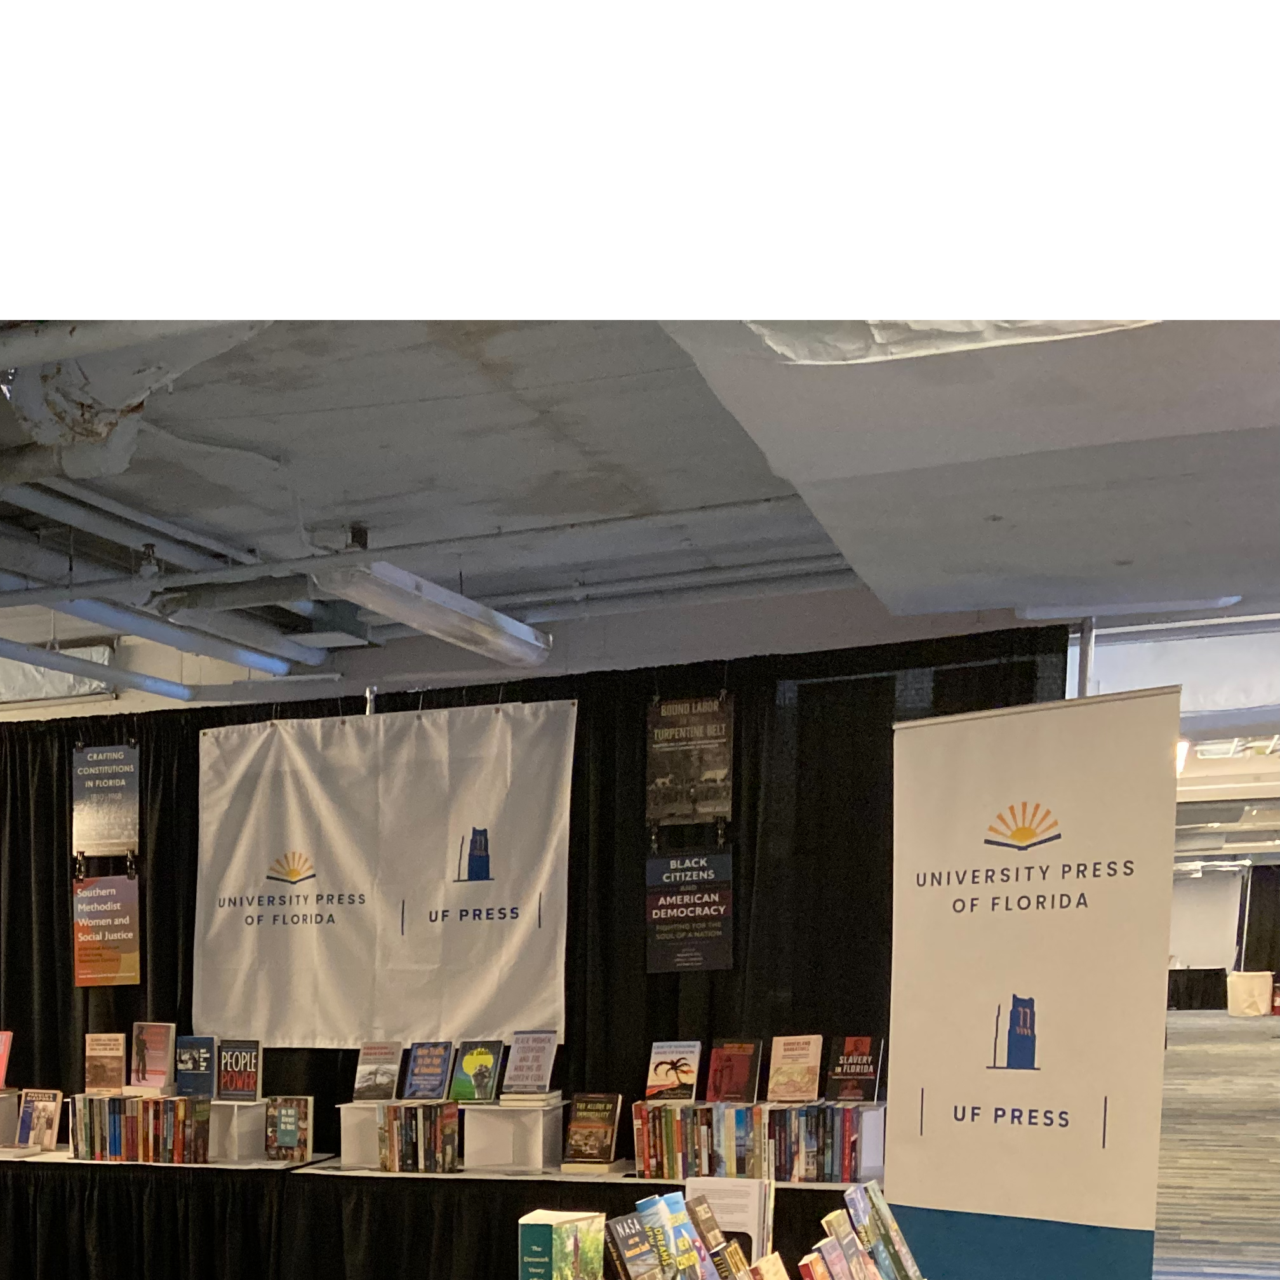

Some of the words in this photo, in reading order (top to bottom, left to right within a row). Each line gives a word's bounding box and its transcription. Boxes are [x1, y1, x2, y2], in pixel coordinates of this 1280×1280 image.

[692, 701, 719, 713] LABOR
[707, 723, 727, 737] BELT
[87, 752, 124, 761] CRAFTING
[77, 765, 134, 775] CONSTITUTIONS
[96, 779, 126, 787] FLORIDA
[670, 858, 708, 869] BLACK
[662, 870, 715, 882] CITIZENS
[916, 865, 1050, 887] UNIVERSITY
[1061, 860, 1134, 879] PRESS
[77, 888, 116, 898] Southern
[658, 893, 719, 906] AMERICAN
[78, 902, 121, 913] Methodist
[218, 894, 309, 909] UNIVERSITY
[316, 893, 366, 906] PRESS
[952, 897, 979, 914] OF
[991, 892, 1088, 912] FLORIDA
[429, 909, 450, 923] UF
[459, 907, 520, 921] PRESS
[652, 905, 726, 919] DEMOCRACY
[78, 918, 112, 927] Women
[114, 916, 130, 925] and
[245, 915, 264, 927] OF
[272, 913, 336, 926] FLORIDA
[78, 931, 102, 942] Social
[105, 930, 133, 941] Justice
[221, 1052, 257, 1072] PEOPLE
[839, 1056, 872, 1064] SLAVERY
[843, 1064, 874, 1073] FLORIDA
[221, 1071, 256, 1091] POWER
[953, 1105, 981, 1123] UF
[993, 1107, 1070, 1128] PRESS
[615, 1218, 642, 1239] NASA
[654, 1227, 671, 1266] DREAMS
